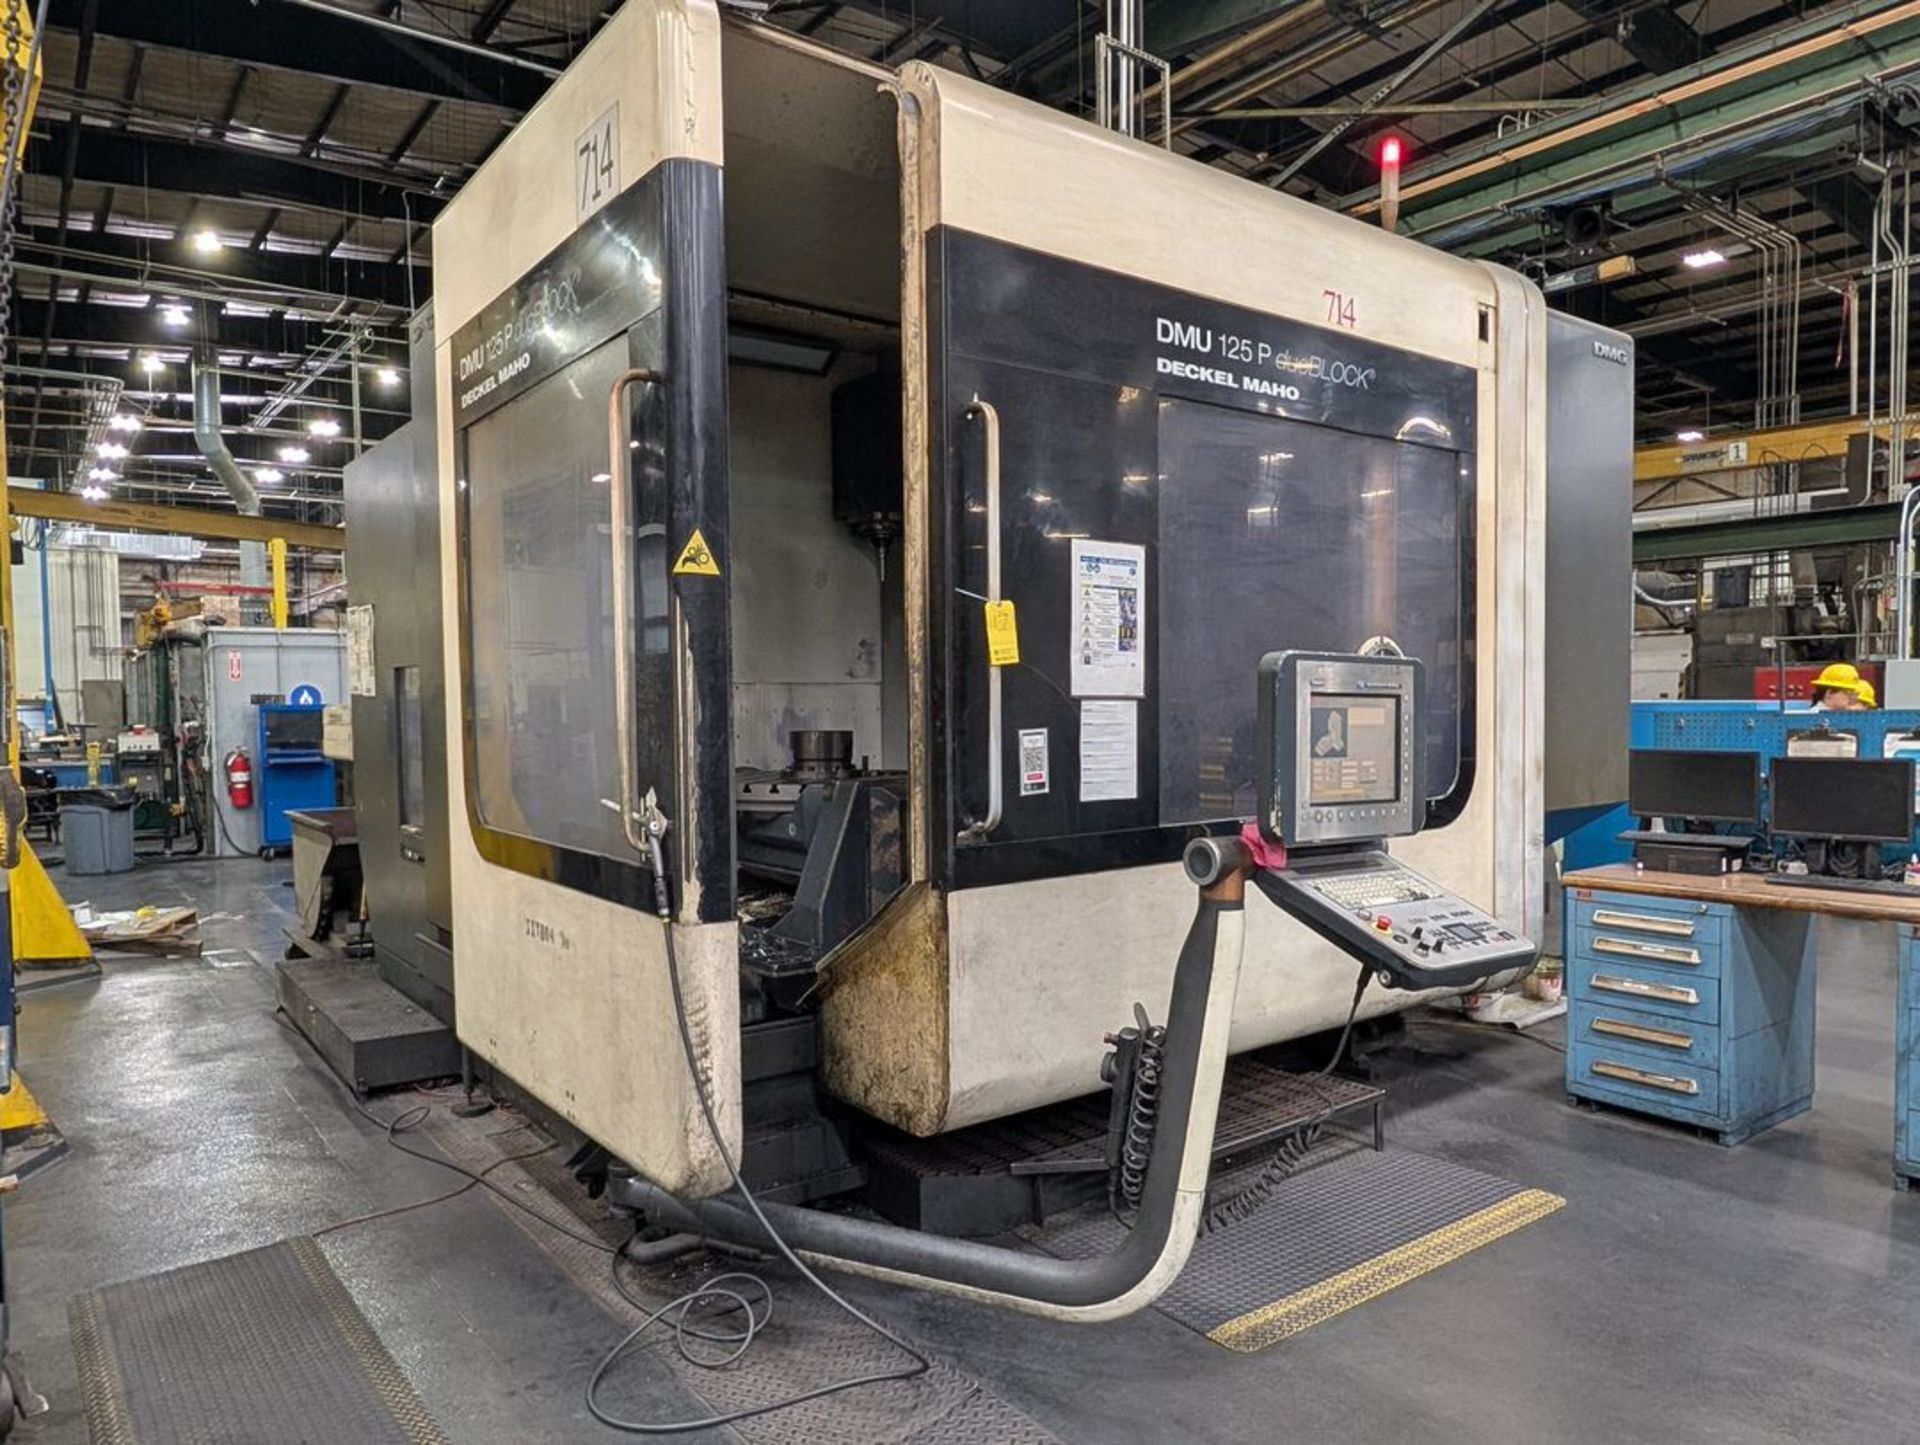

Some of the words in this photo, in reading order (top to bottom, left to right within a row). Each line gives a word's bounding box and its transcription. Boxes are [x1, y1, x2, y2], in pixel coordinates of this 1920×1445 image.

[579, 121, 614, 210] 714
[1322, 289, 1357, 328] 714
[460, 344, 485, 381] DMU
[486, 330, 504, 361] 125
[504, 322, 513, 350] P
[1156, 317, 1212, 353] DMU
[1218, 333, 1253, 363] 125
[1258, 342, 1272, 365] P
[1593, 340, 1628, 364] DMG
[461, 375, 498, 410] DECKEL
[498, 352, 531, 385] MAHO
[1156, 356, 1240, 389] DECKEL
[1242, 376, 1300, 401] MAHO
[1733, 444, 1740, 459] 1
